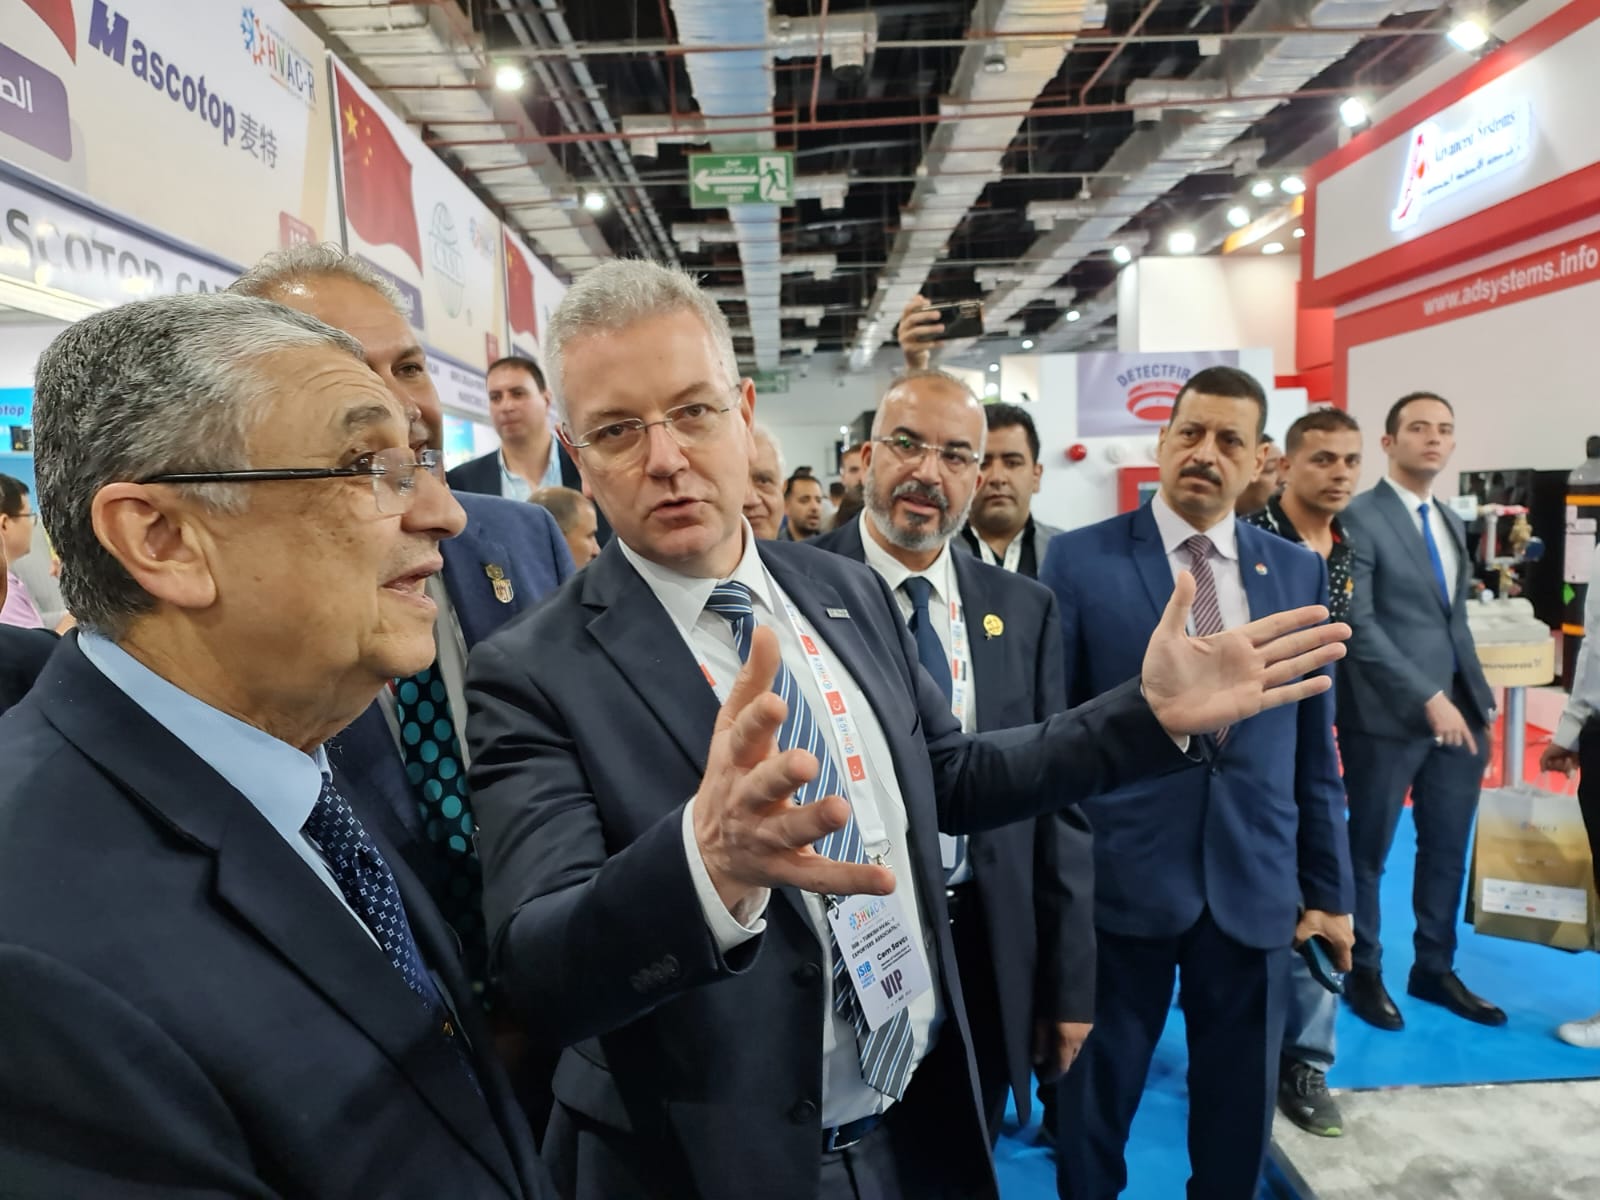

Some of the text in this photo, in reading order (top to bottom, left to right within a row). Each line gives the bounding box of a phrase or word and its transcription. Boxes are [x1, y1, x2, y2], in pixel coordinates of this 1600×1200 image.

[88, 0, 236, 146] Mascotop
[239, 111, 279, 169] 麦特
[1423, 244, 1599, 317] www.adsystems.info
[1117, 365, 1190, 386] DETECTFIR
[877, 948, 891, 960] Cem
[881, 969, 902, 998] VIP
